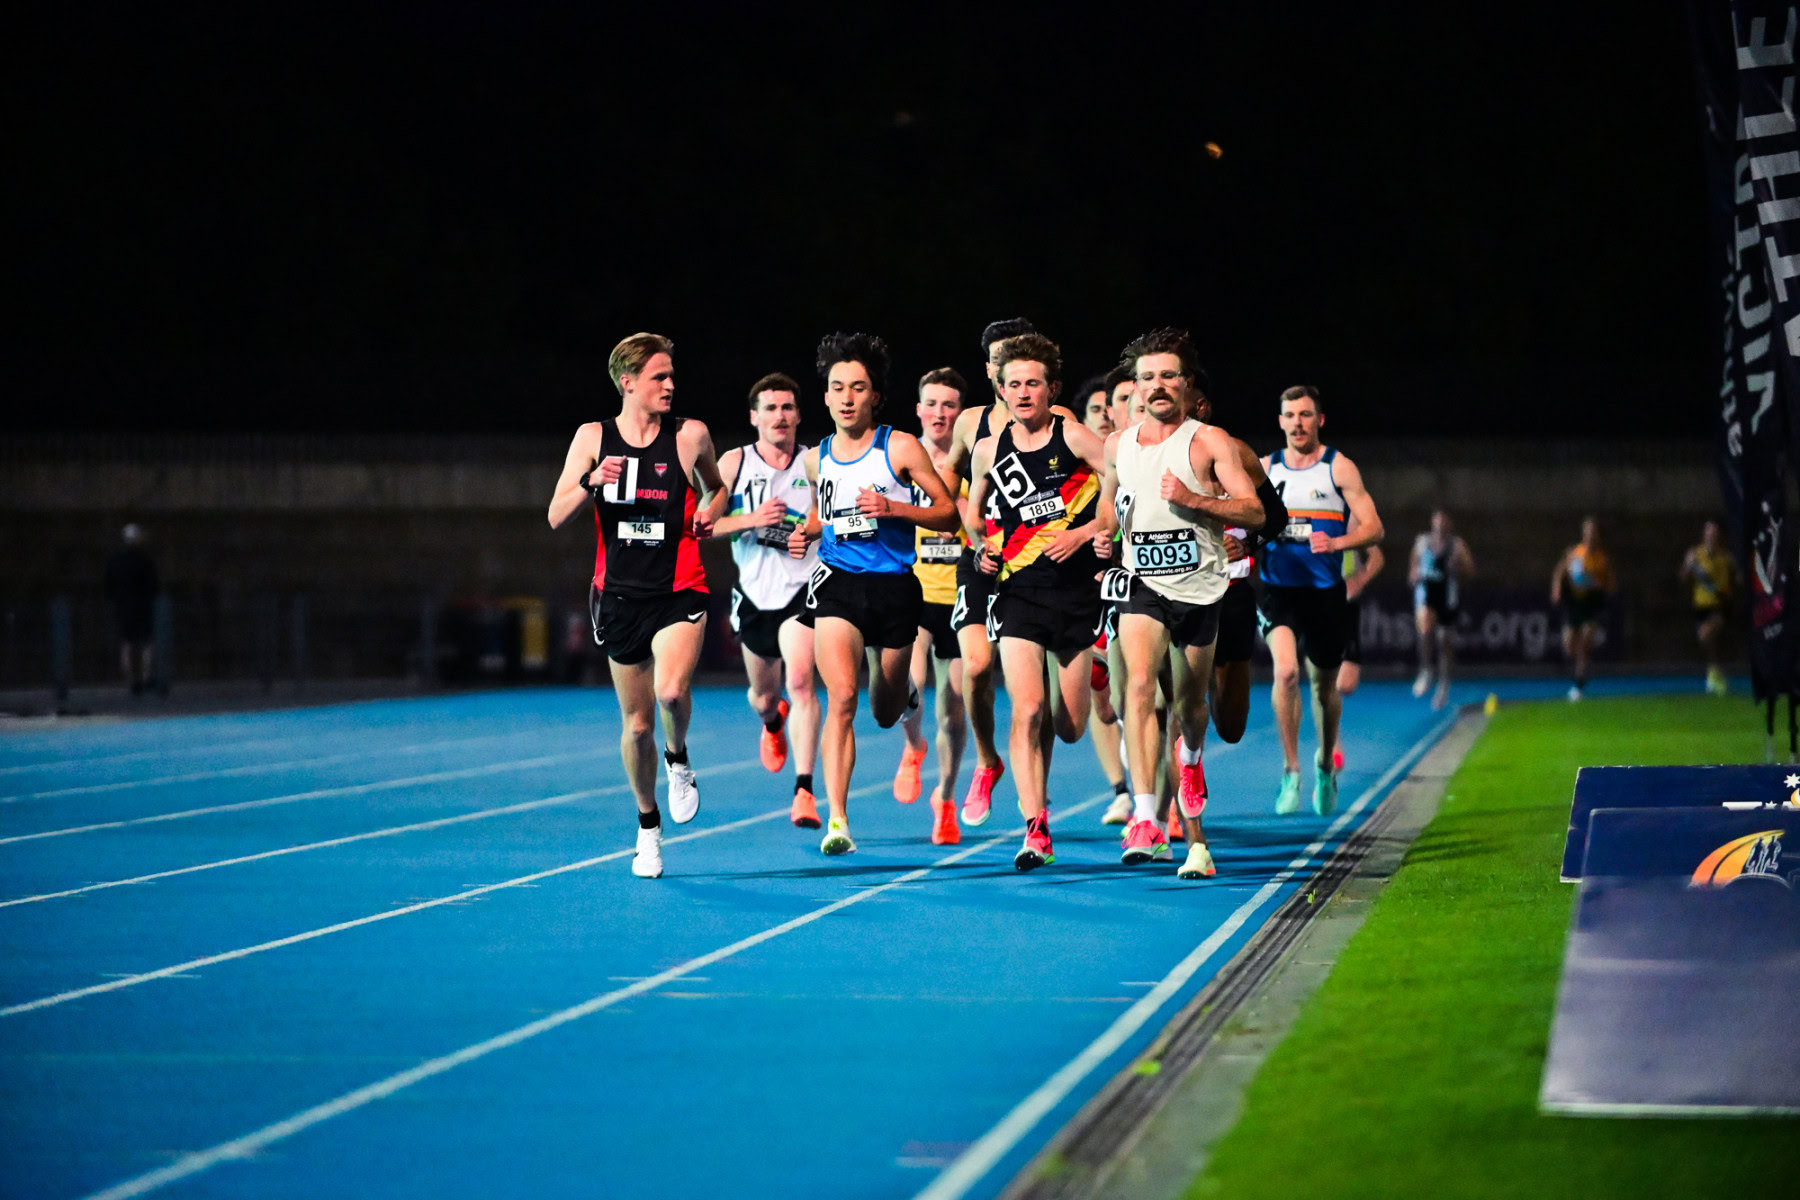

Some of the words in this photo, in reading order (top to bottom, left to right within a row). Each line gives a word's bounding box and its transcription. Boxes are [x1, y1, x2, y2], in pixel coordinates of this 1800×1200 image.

[996, 456, 1028, 499] 5
[819, 478, 834, 521] 18
[1029, 500, 1057, 517] 1819
[631, 523, 652, 534] 145
[848, 516, 862, 527] 95
[1148, 533, 1173, 541] Athletics
[930, 546, 954, 556] 1745
[1137, 543, 1192, 567] 6093
[1107, 571, 1130, 599] 10
